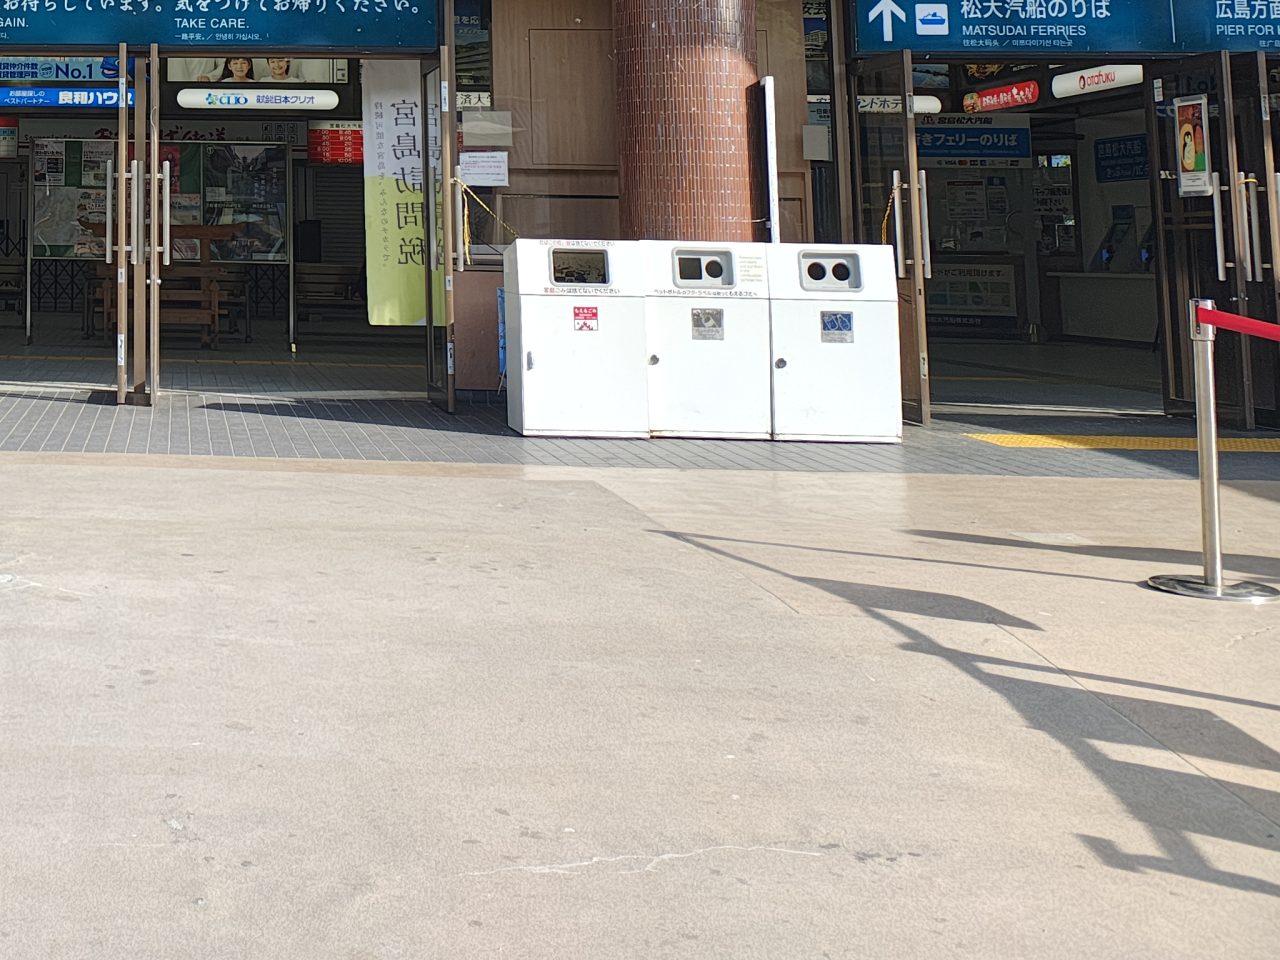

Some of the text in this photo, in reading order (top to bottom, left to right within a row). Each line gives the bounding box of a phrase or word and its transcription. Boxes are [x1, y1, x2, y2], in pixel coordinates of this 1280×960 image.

[174, 17, 250, 29] TAKE CARE.
[962, 25, 1087, 37] MATSUDAI FERRIES
[1216, 24, 1274, 36] PIER FOR
[55, 63, 93, 79] No.1
[3, 97, 50, 105] ベストパートナー
